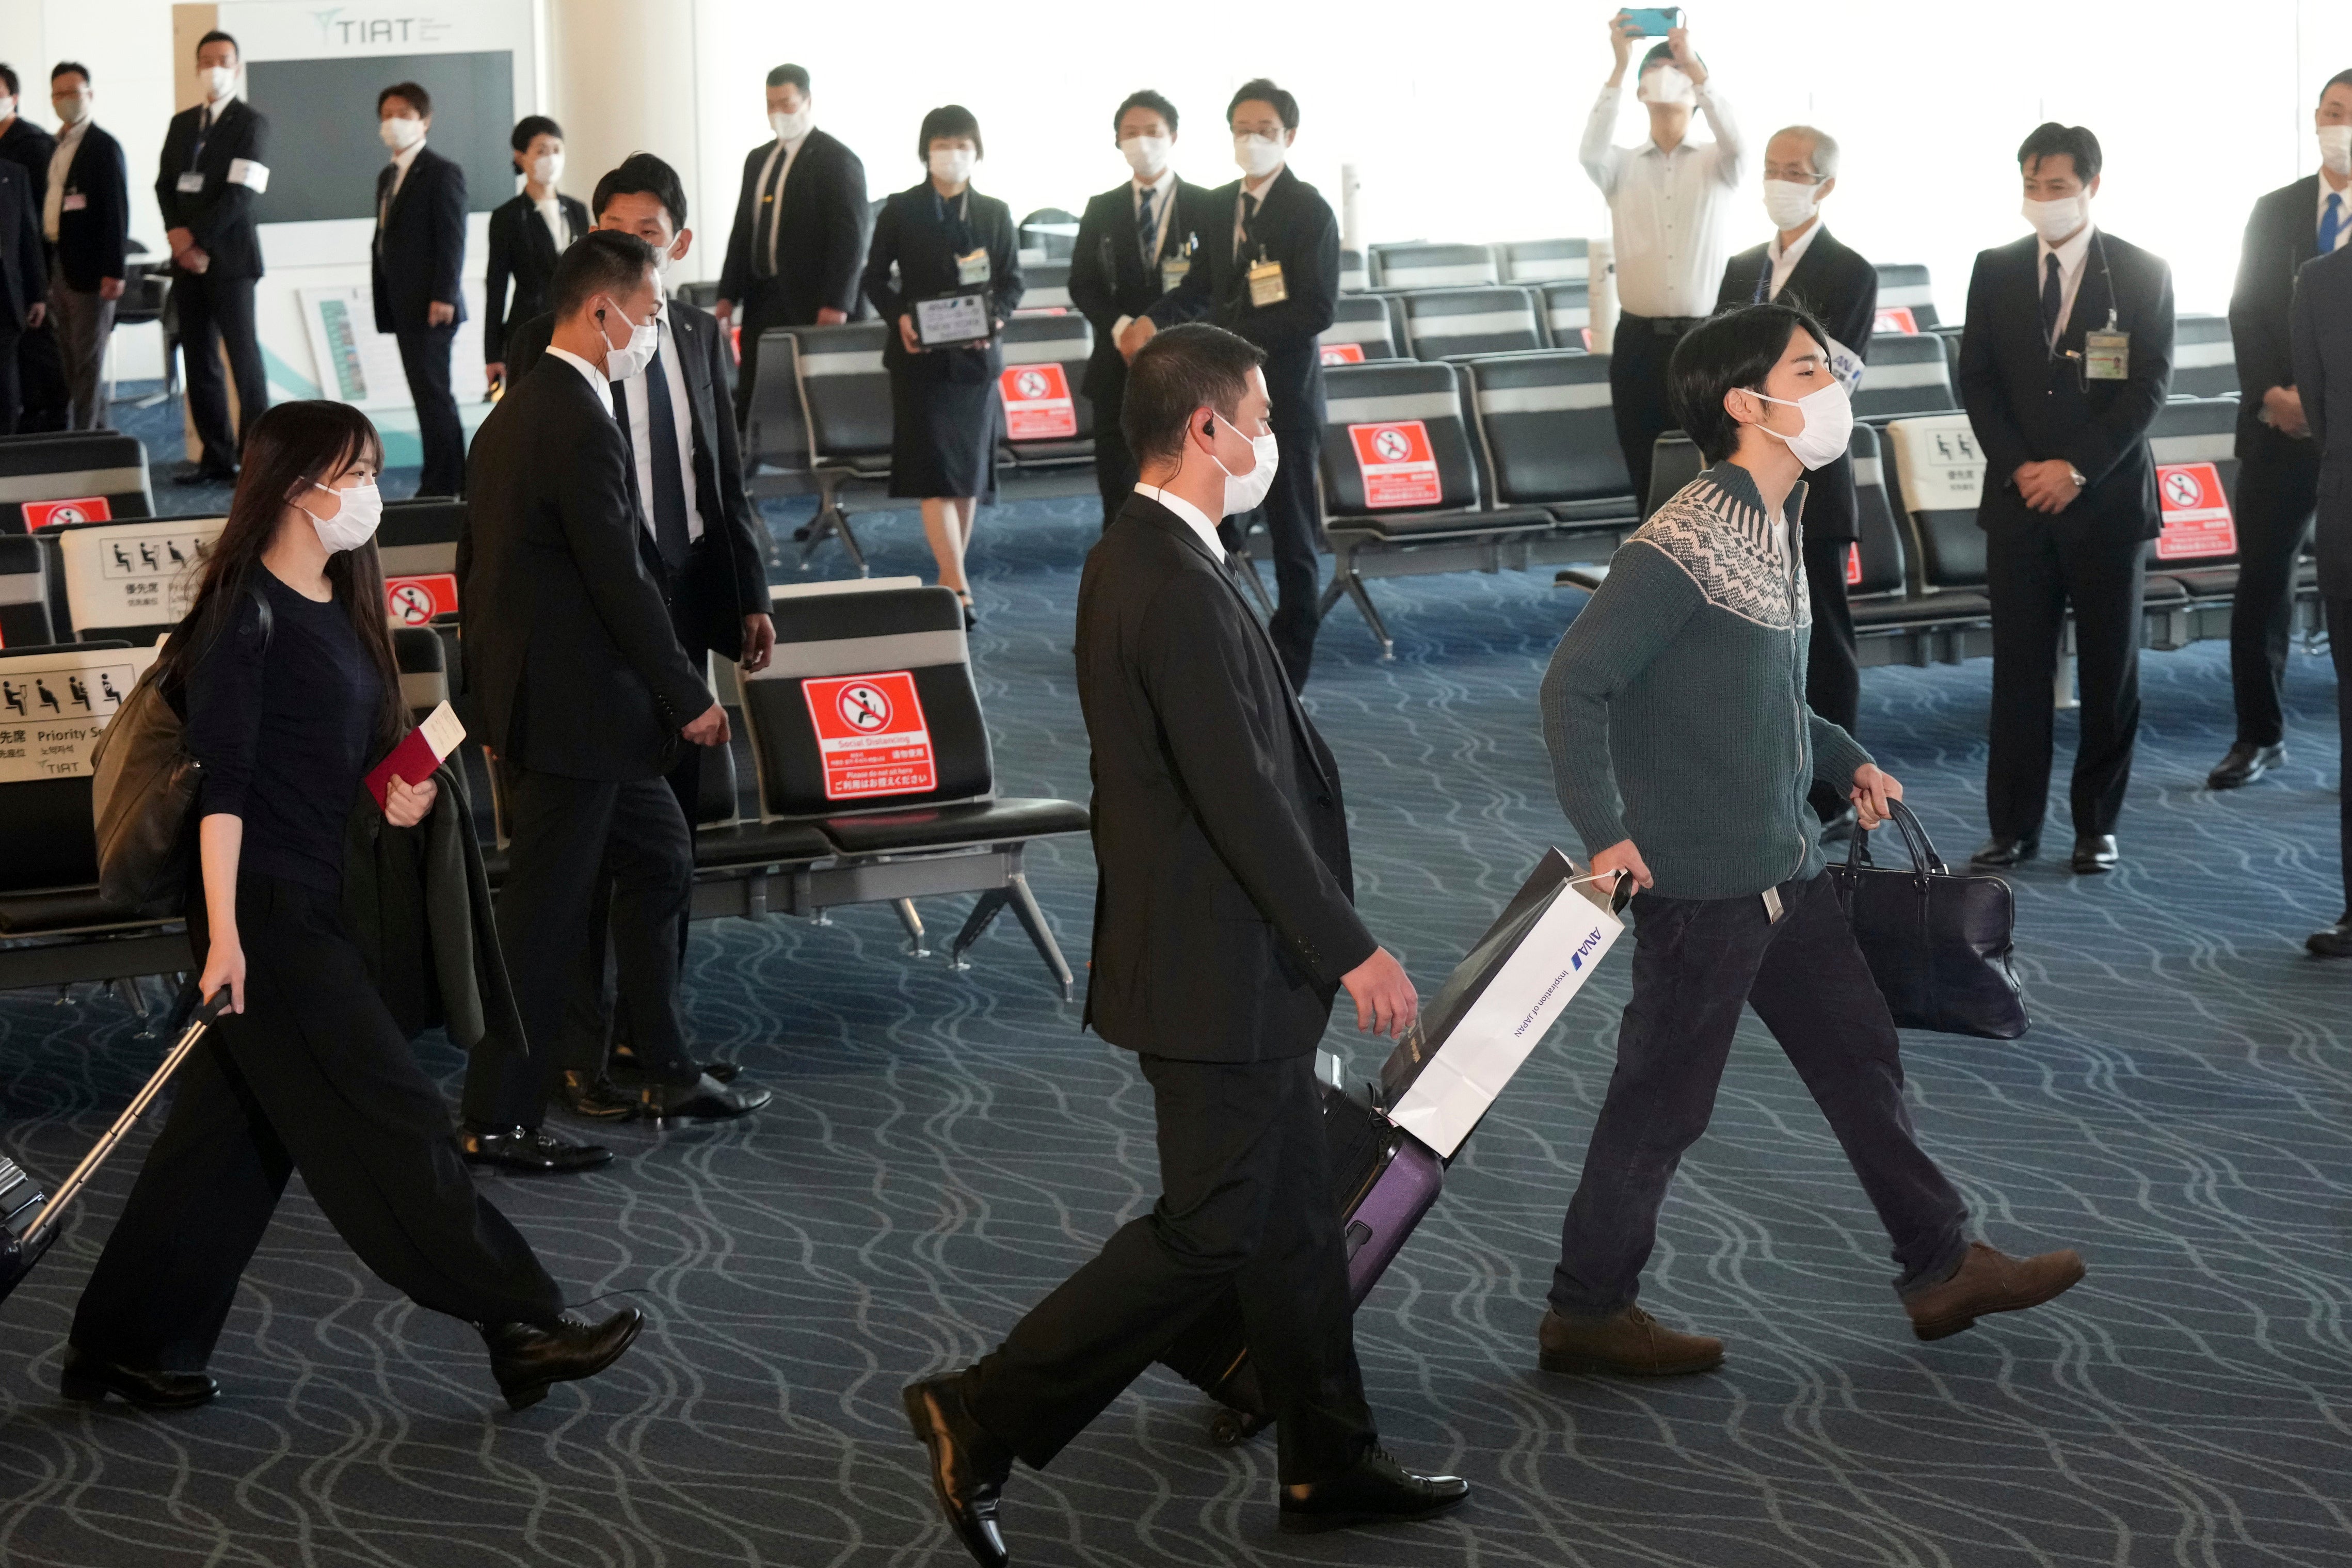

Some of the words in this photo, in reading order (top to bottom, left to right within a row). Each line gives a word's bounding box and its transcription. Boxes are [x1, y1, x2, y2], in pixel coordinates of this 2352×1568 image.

[336, 19, 414, 44] TIAT
[38, 729, 87, 741] Priority
[838, 739, 863, 748] Social
[866, 736, 910, 746] Distancing
[47, 762, 79, 774] TIAT
[1577, 926, 1601, 956] ANA
[1538, 970, 1569, 1006] Inspiration
[1532, 1005, 1539, 1016] of
[1514, 1013, 1534, 1037] JAPAN
